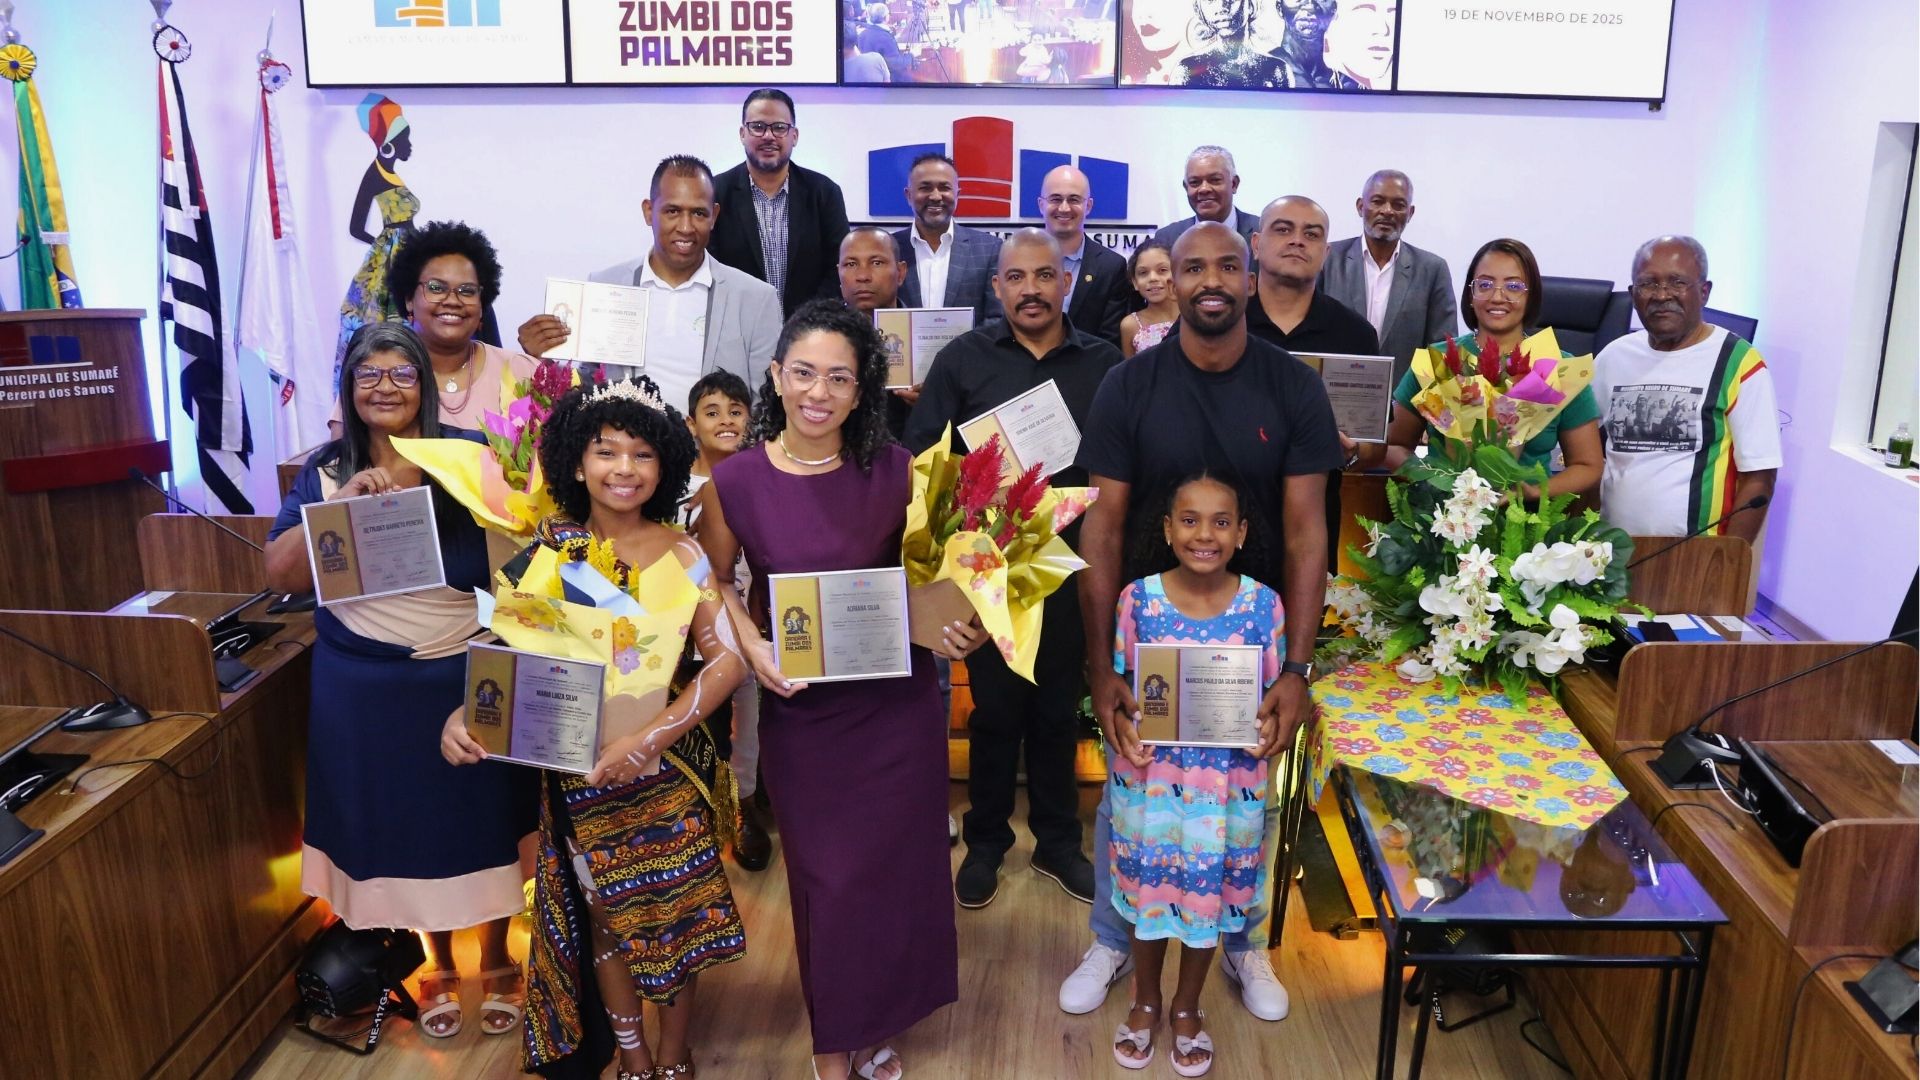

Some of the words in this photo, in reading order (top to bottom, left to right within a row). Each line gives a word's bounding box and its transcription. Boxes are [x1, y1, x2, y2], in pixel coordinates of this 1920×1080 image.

[619, 1, 720, 31] ZUMBI
[731, 1, 793, 31] DOS
[1444, 9, 1456, 19] 19
[1461, 10, 1479, 20] DE
[1484, 10, 1565, 23] NOVEMBRO
[1569, 13, 1587, 23] DE
[1592, 13, 1623, 25] 2025
[620, 36, 793, 66] PALMARES
[56, 372, 70, 383] DE
[73, 365, 119, 382] SUMARÉ
[0, 389, 46, 401] Pereira
[48, 387, 71, 399] dos
[74, 384, 115, 396] Santos
[536, 689, 551, 699] MARIA
[551, 690, 565, 700] LUIZA
[565, 692, 578, 702] SILVA
[1433, 992, 1443, 1022] NE-1
